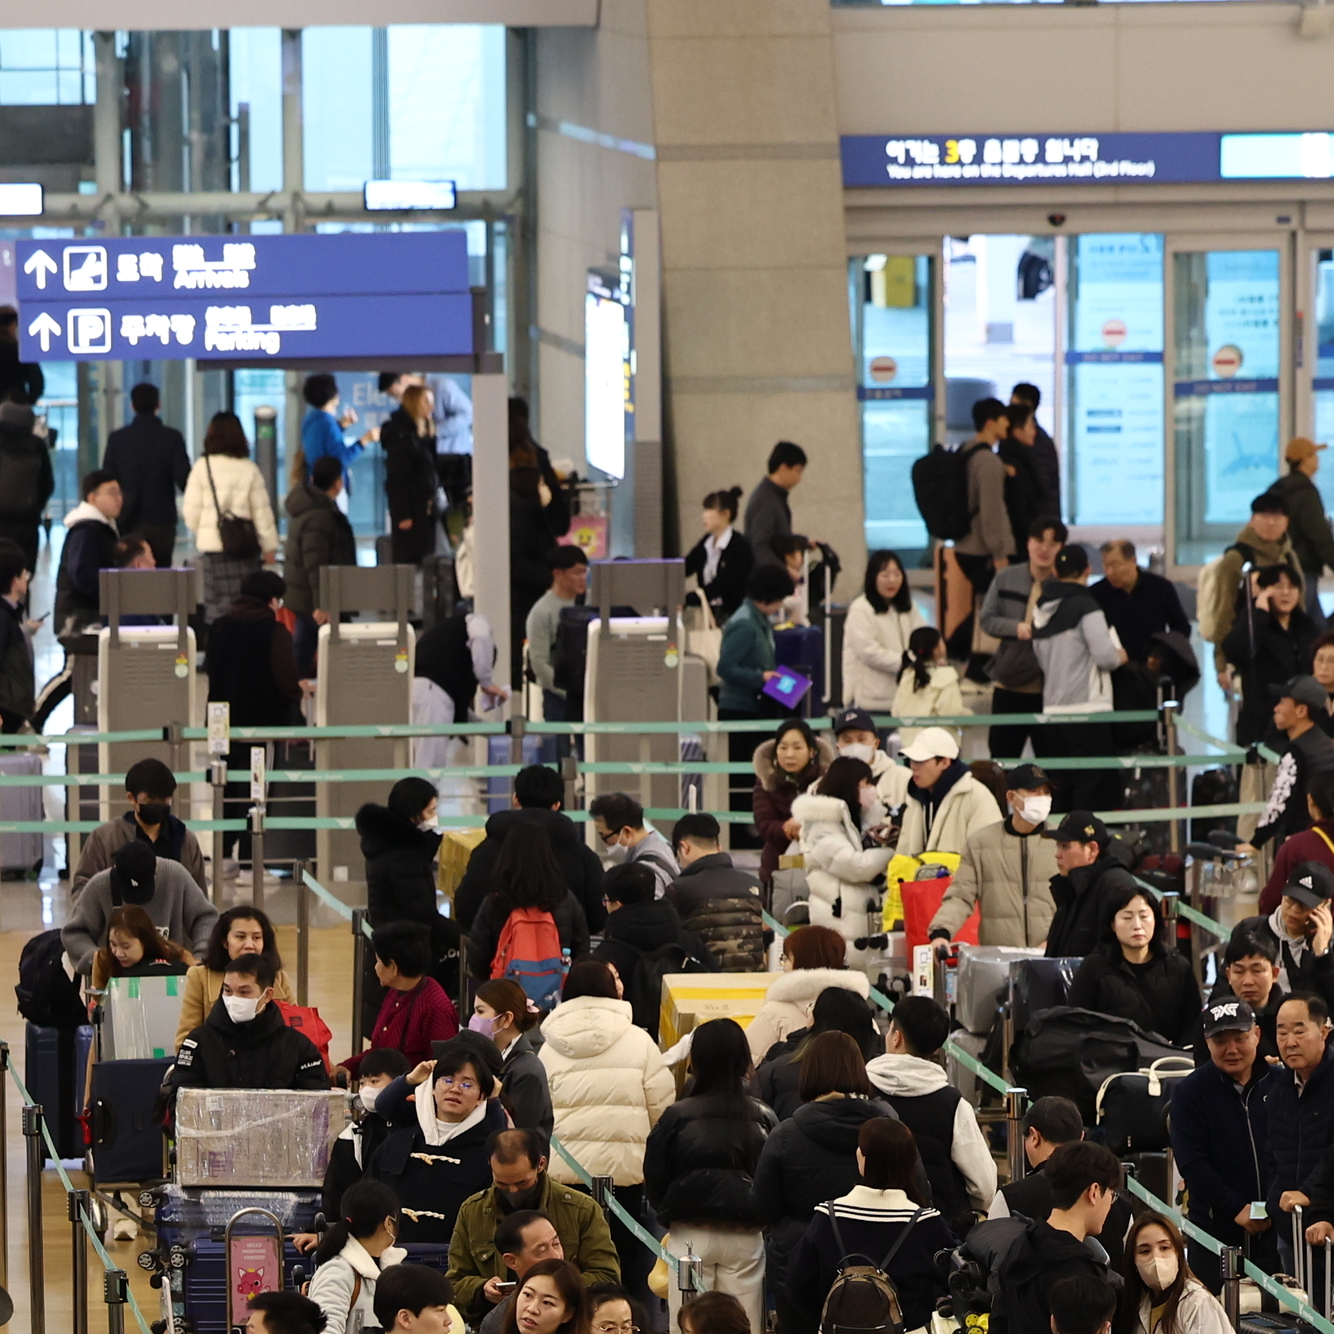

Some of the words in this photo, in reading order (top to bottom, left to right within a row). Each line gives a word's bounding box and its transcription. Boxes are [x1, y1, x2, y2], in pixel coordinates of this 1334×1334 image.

[116, 252, 163, 282] 도착
[120, 314, 196, 345] 주차장
[204, 326, 281, 354] Parking
